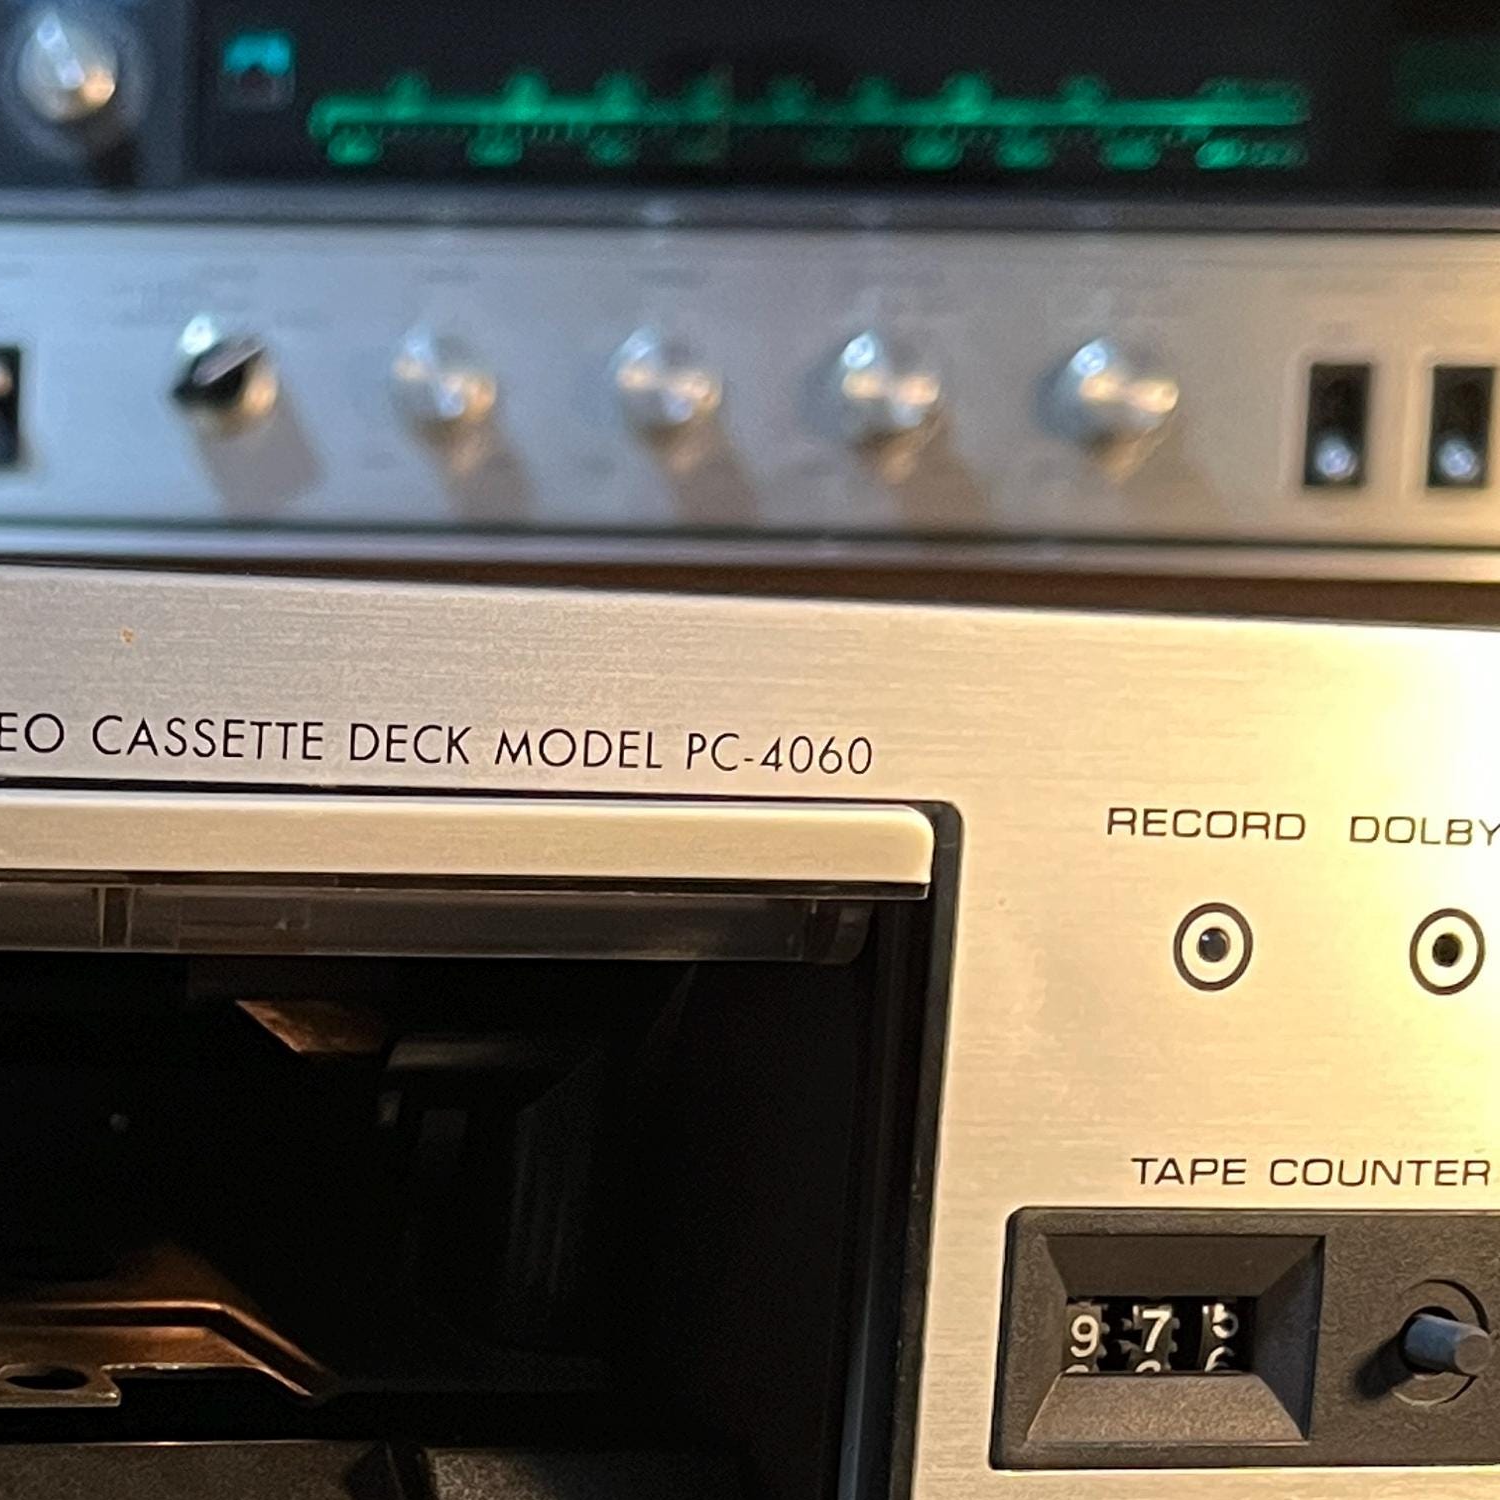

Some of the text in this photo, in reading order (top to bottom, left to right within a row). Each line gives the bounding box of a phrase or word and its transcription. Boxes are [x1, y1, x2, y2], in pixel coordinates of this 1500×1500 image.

[92, 714, 324, 761] CASSETTE
[350, 723, 472, 765] DECK
[494, 728, 662, 769] MODEL
[686, 732, 872, 775] PC-4060
[1107, 807, 1306, 841] RECORD
[1349, 815, 1500, 846] DOLBY
[1131, 1157, 1491, 1187] TAPE COUNTER
